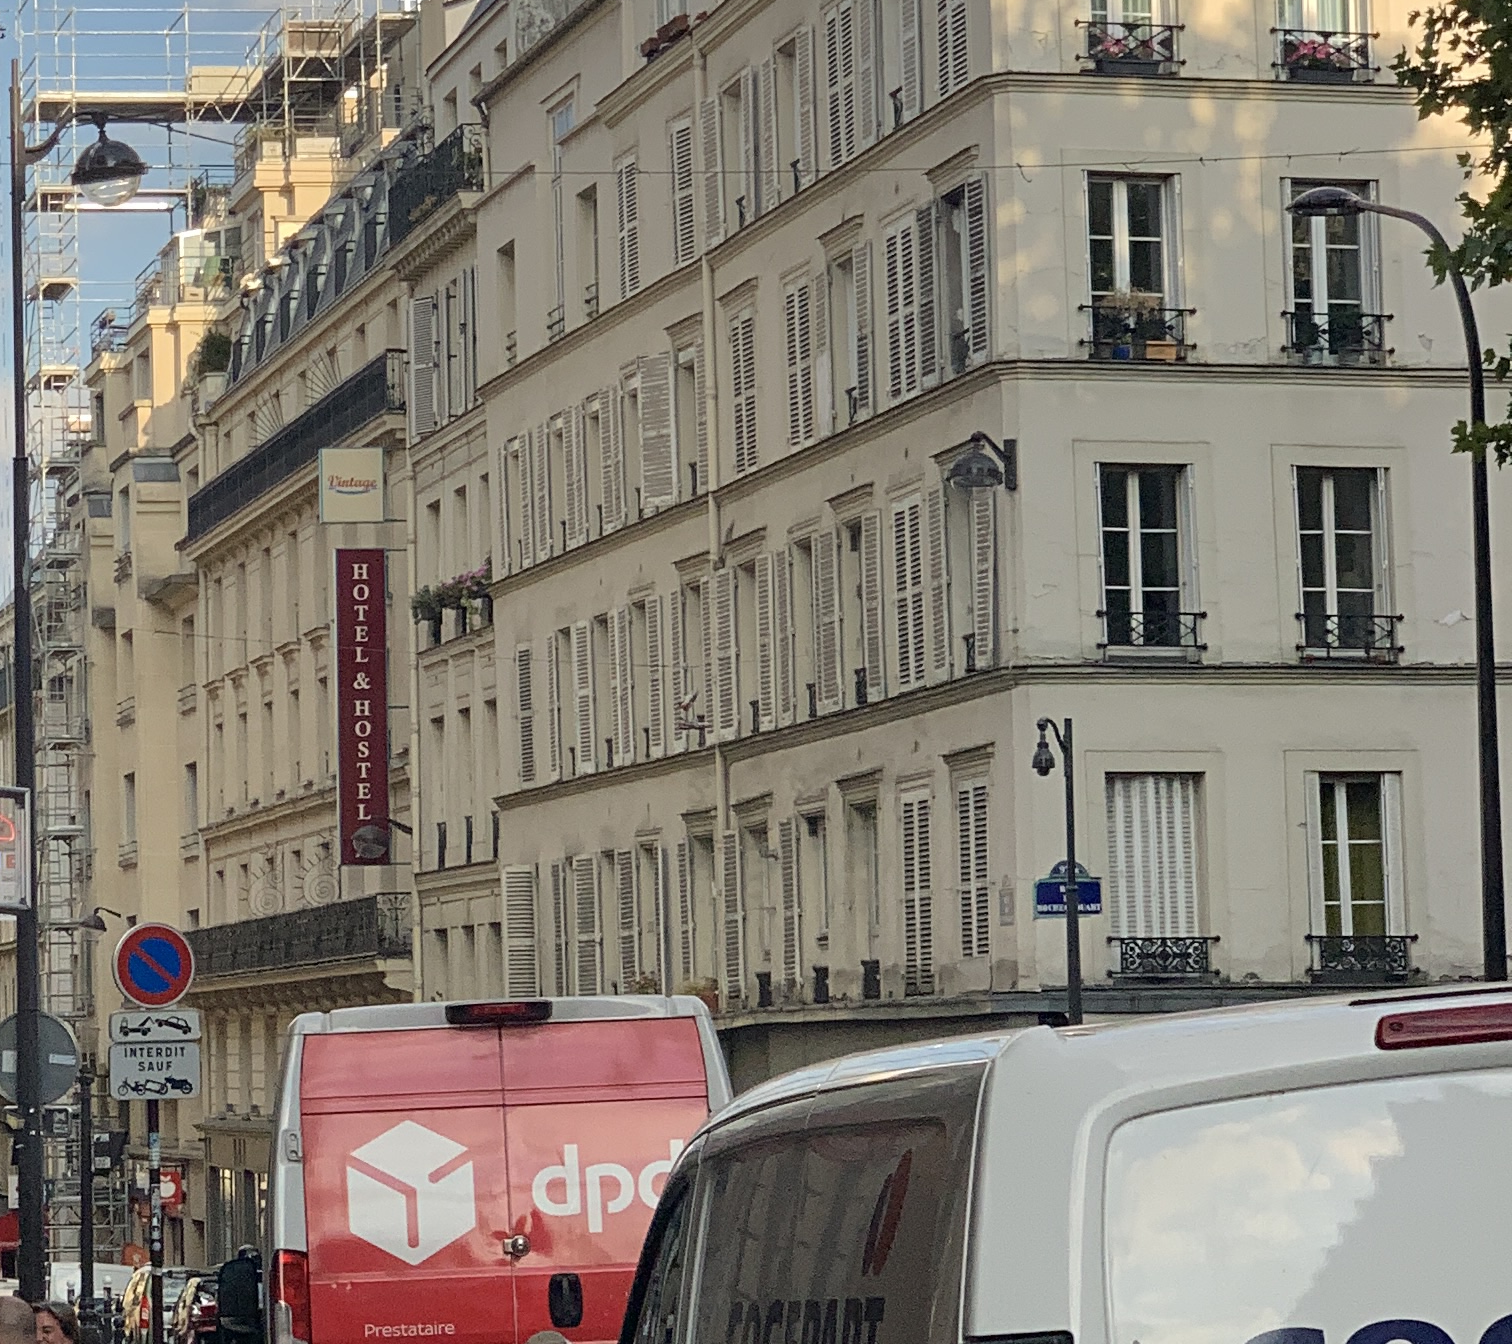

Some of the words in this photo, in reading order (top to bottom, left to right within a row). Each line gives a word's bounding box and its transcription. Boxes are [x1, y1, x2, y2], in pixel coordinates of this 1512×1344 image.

[327, 474, 378, 491] Vintage
[351, 563, 370, 664] HOTEL
[352, 672, 372, 691] &
[354, 699, 373, 821] HOSTEL
[124, 1046, 186, 1058] INTERDIT
[138, 1061, 173, 1072] SAUF
[364, 1321, 456, 1338] Prestataire
